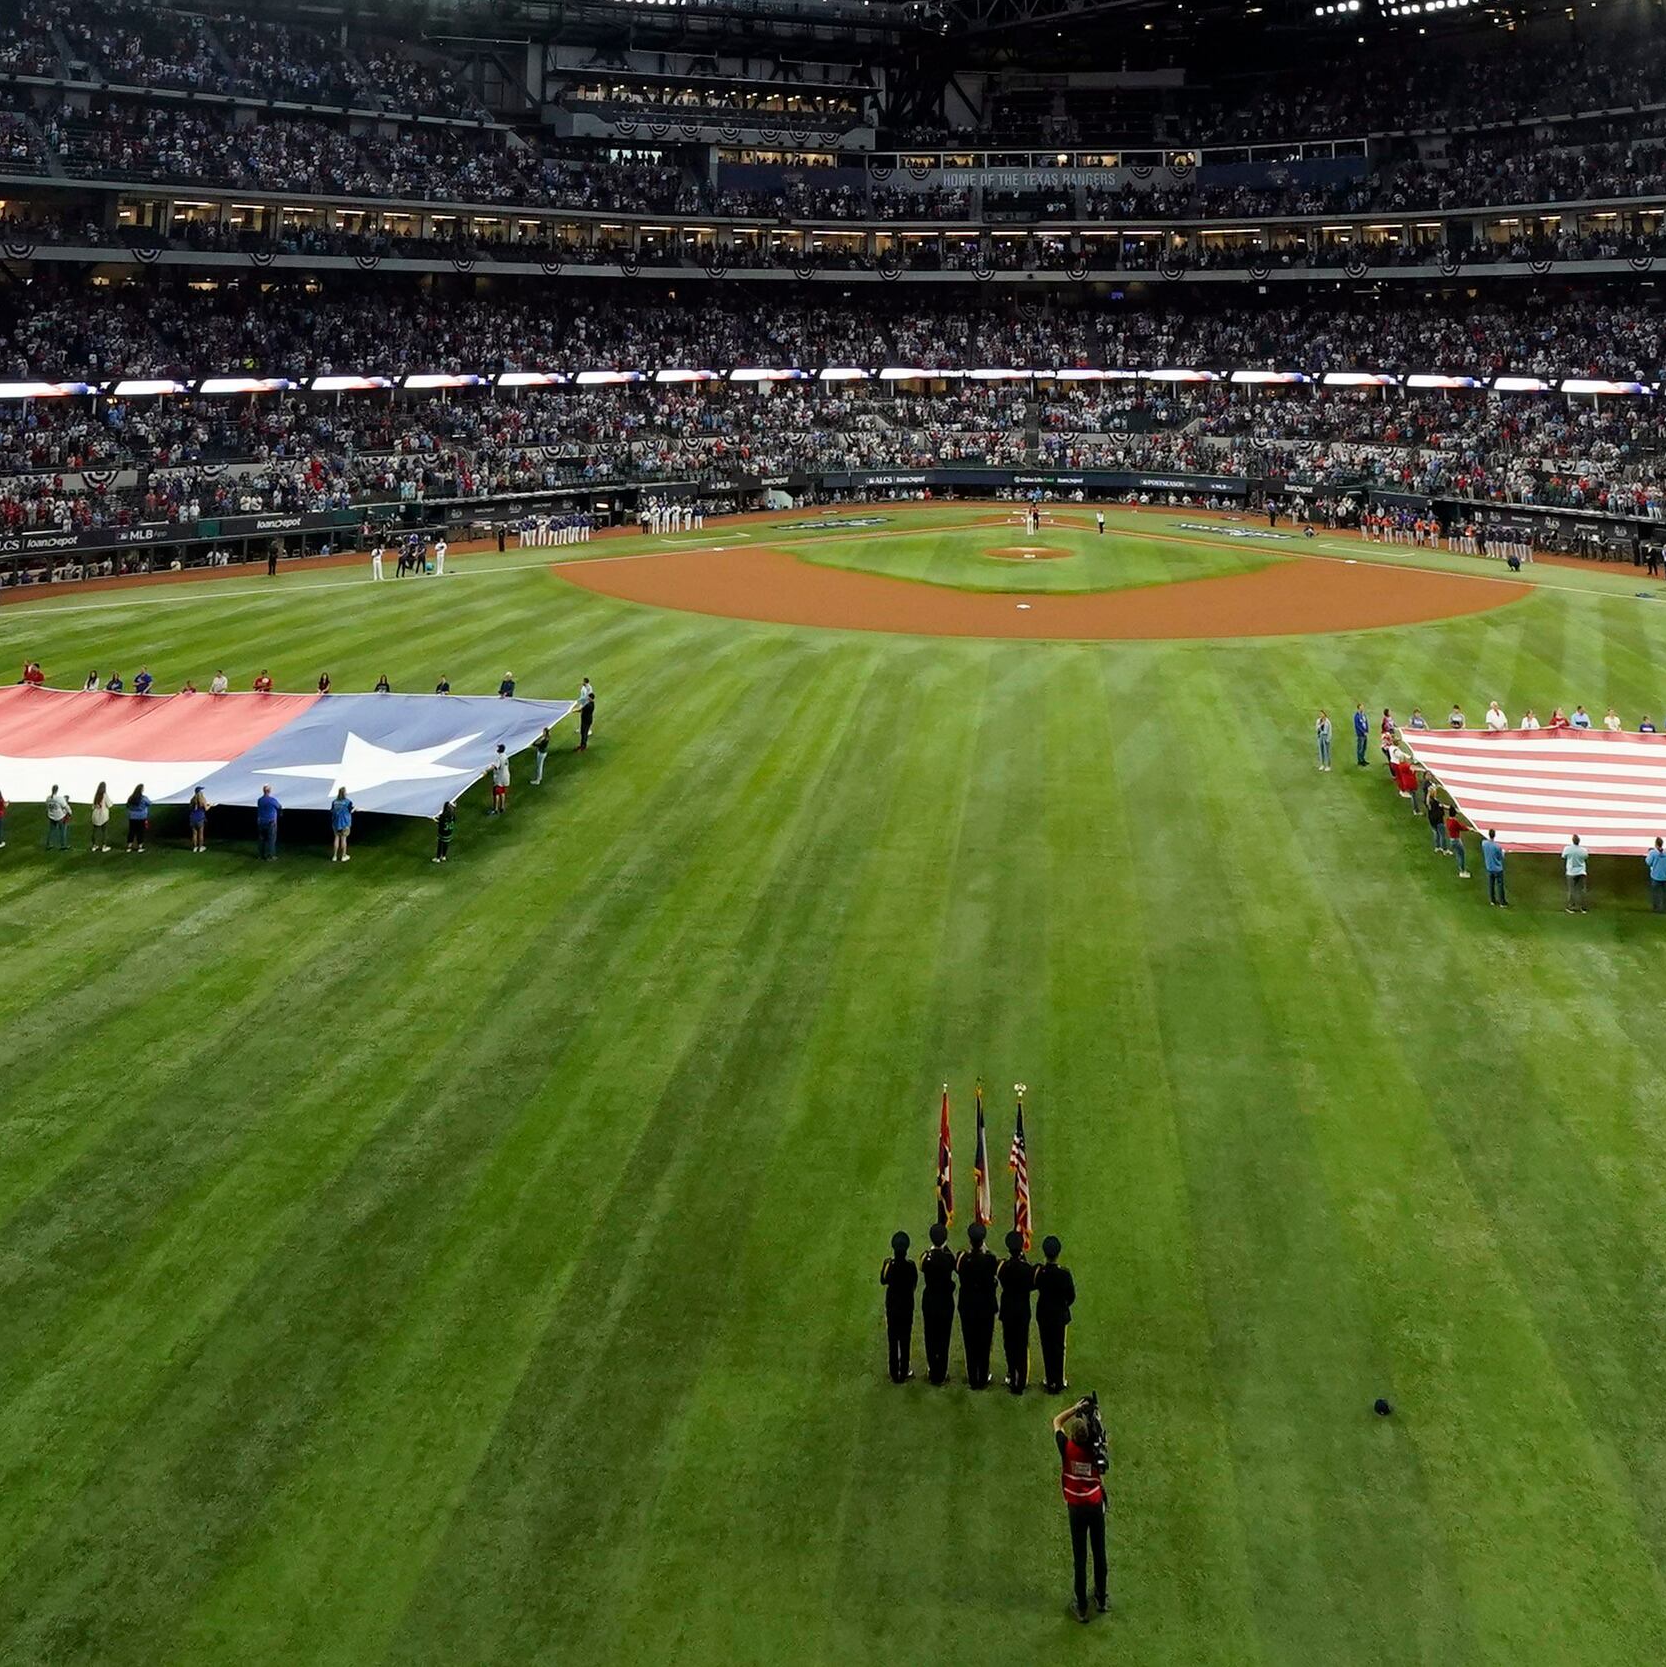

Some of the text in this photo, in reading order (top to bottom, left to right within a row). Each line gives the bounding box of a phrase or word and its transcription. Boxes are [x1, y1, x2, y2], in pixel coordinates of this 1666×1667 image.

[943, 173, 1116, 186] HOME OF THE TEXAS RANGERS
[129, 529, 153, 540] MLB
[26, 536, 79, 549] loanDepot
